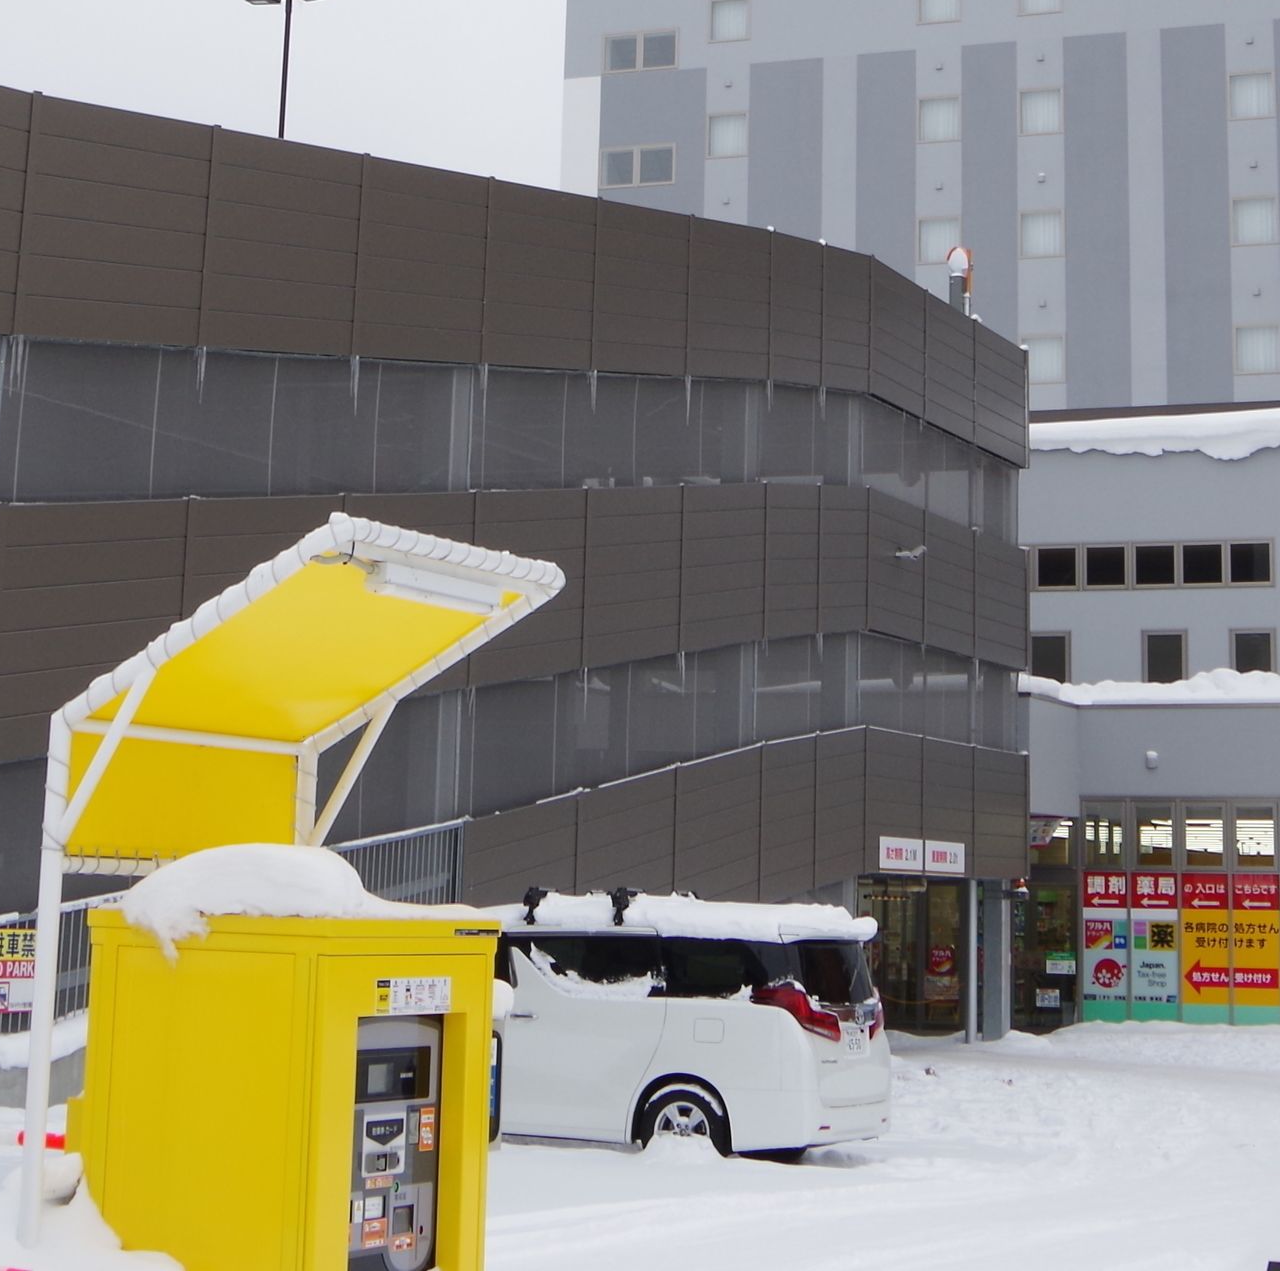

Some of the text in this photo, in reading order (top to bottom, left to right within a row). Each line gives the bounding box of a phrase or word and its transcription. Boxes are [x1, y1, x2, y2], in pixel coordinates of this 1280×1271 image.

[1087, 921, 1111, 931] ツルハ
[6, 960, 35, 978] PARK
